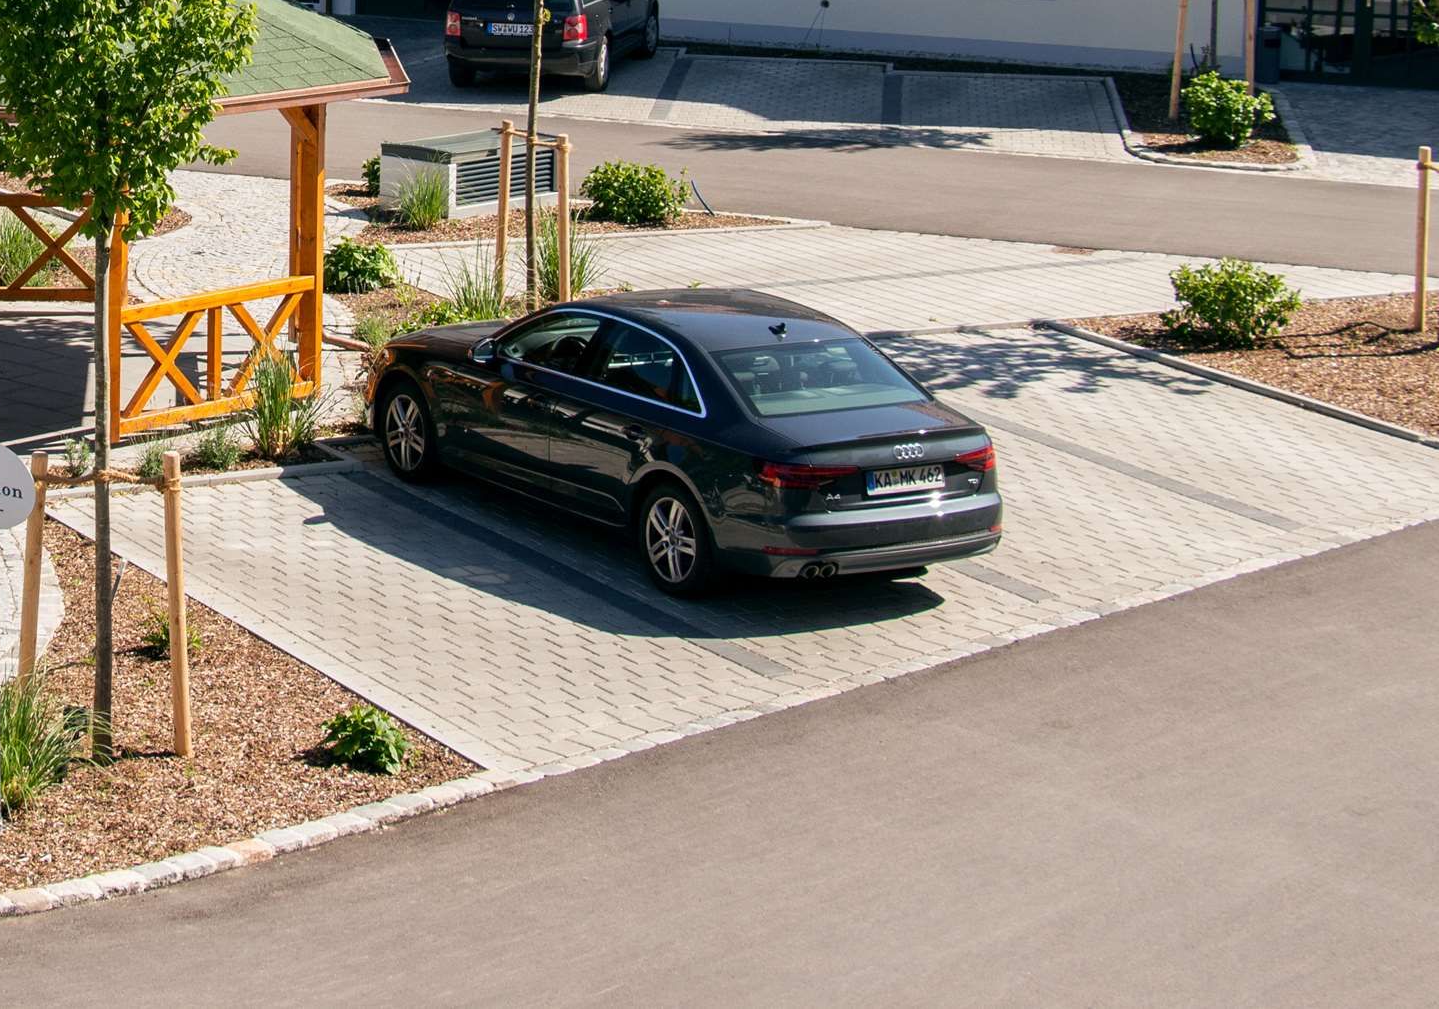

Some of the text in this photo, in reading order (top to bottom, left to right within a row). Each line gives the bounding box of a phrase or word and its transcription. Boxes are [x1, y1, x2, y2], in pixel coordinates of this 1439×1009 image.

[875, 467, 942, 488] KA MK 462
[825, 493, 841, 501] A4
